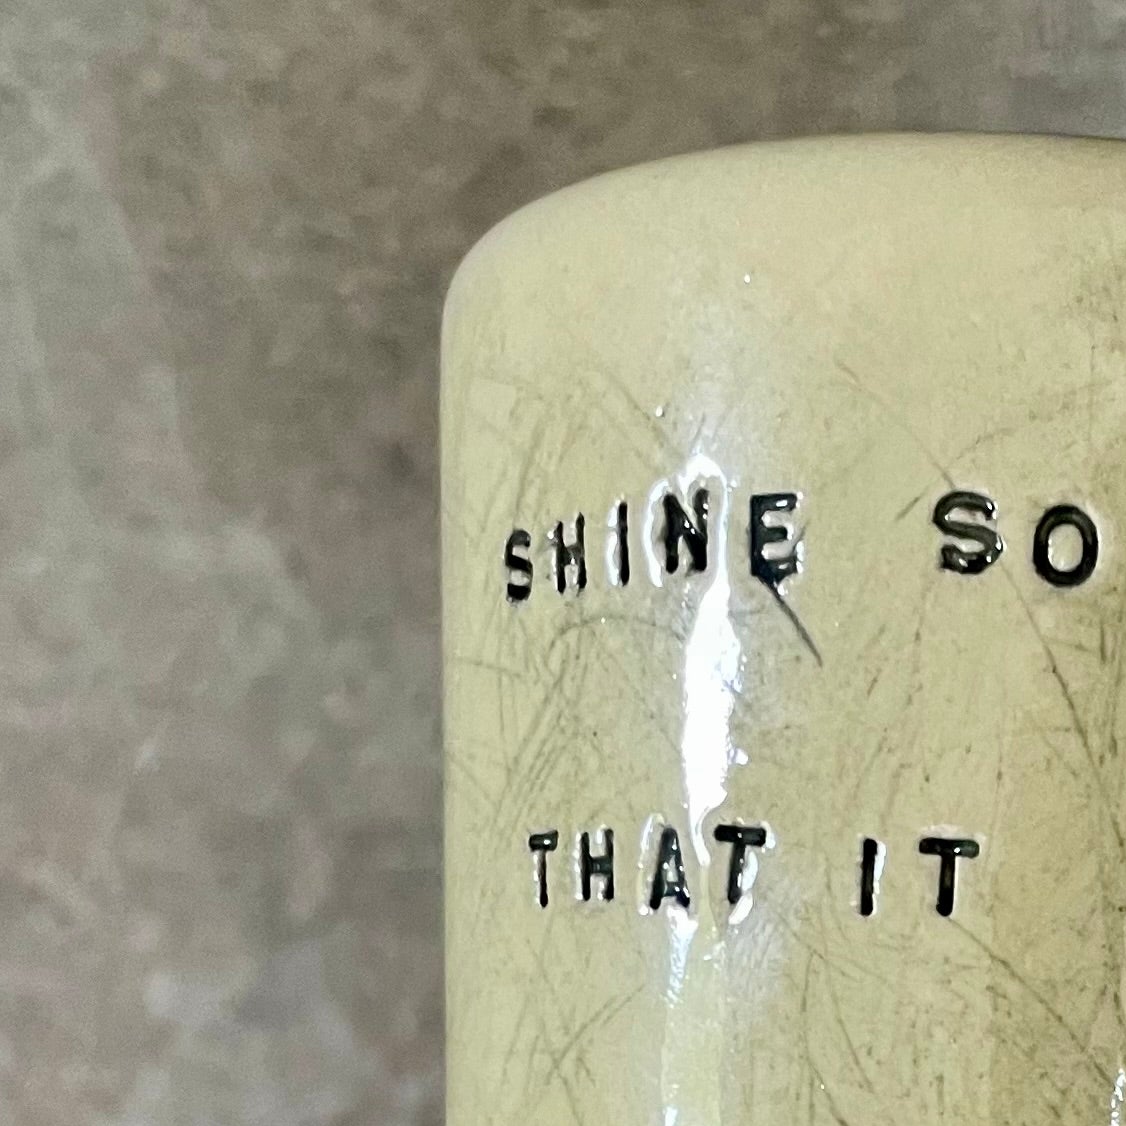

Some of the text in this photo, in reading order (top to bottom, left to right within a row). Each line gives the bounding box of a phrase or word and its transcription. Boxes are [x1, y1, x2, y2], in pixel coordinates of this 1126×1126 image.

[505, 489, 799, 602] SHINE
[932, 491, 1100, 588] SO
[528, 824, 768, 911] THAT
[860, 837, 981, 917] IT
